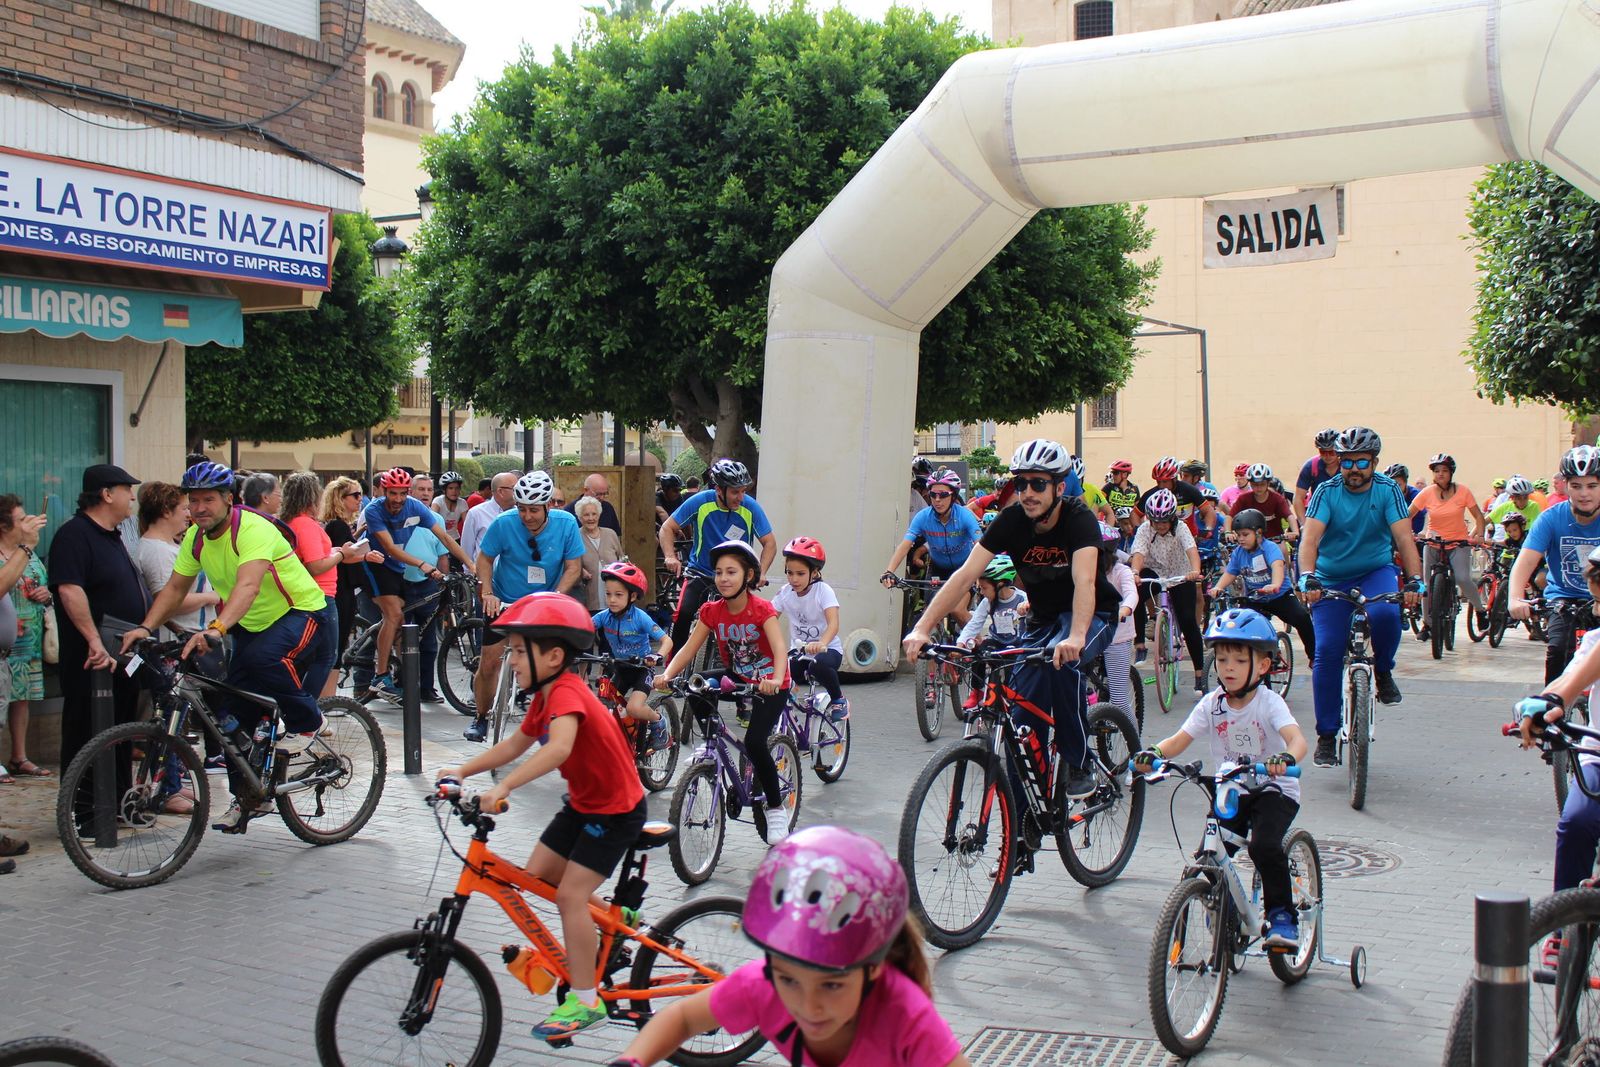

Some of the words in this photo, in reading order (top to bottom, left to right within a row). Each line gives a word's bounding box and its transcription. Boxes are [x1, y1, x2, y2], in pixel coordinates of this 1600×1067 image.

[36, 177, 83, 219] LA
[93, 187, 208, 238] TORRE
[218, 208, 325, 256] NAZARÍ
[1216, 203, 1326, 257] SALIDA
[64, 231, 229, 266] ASESORAMIENTO
[233, 254, 326, 280] EMPRESAS.
[0, 284, 131, 329] ILIARIAS
[718, 623, 761, 641] LOIS
[1234, 734, 1252, 747] 59
[497, 888, 570, 972] megam
